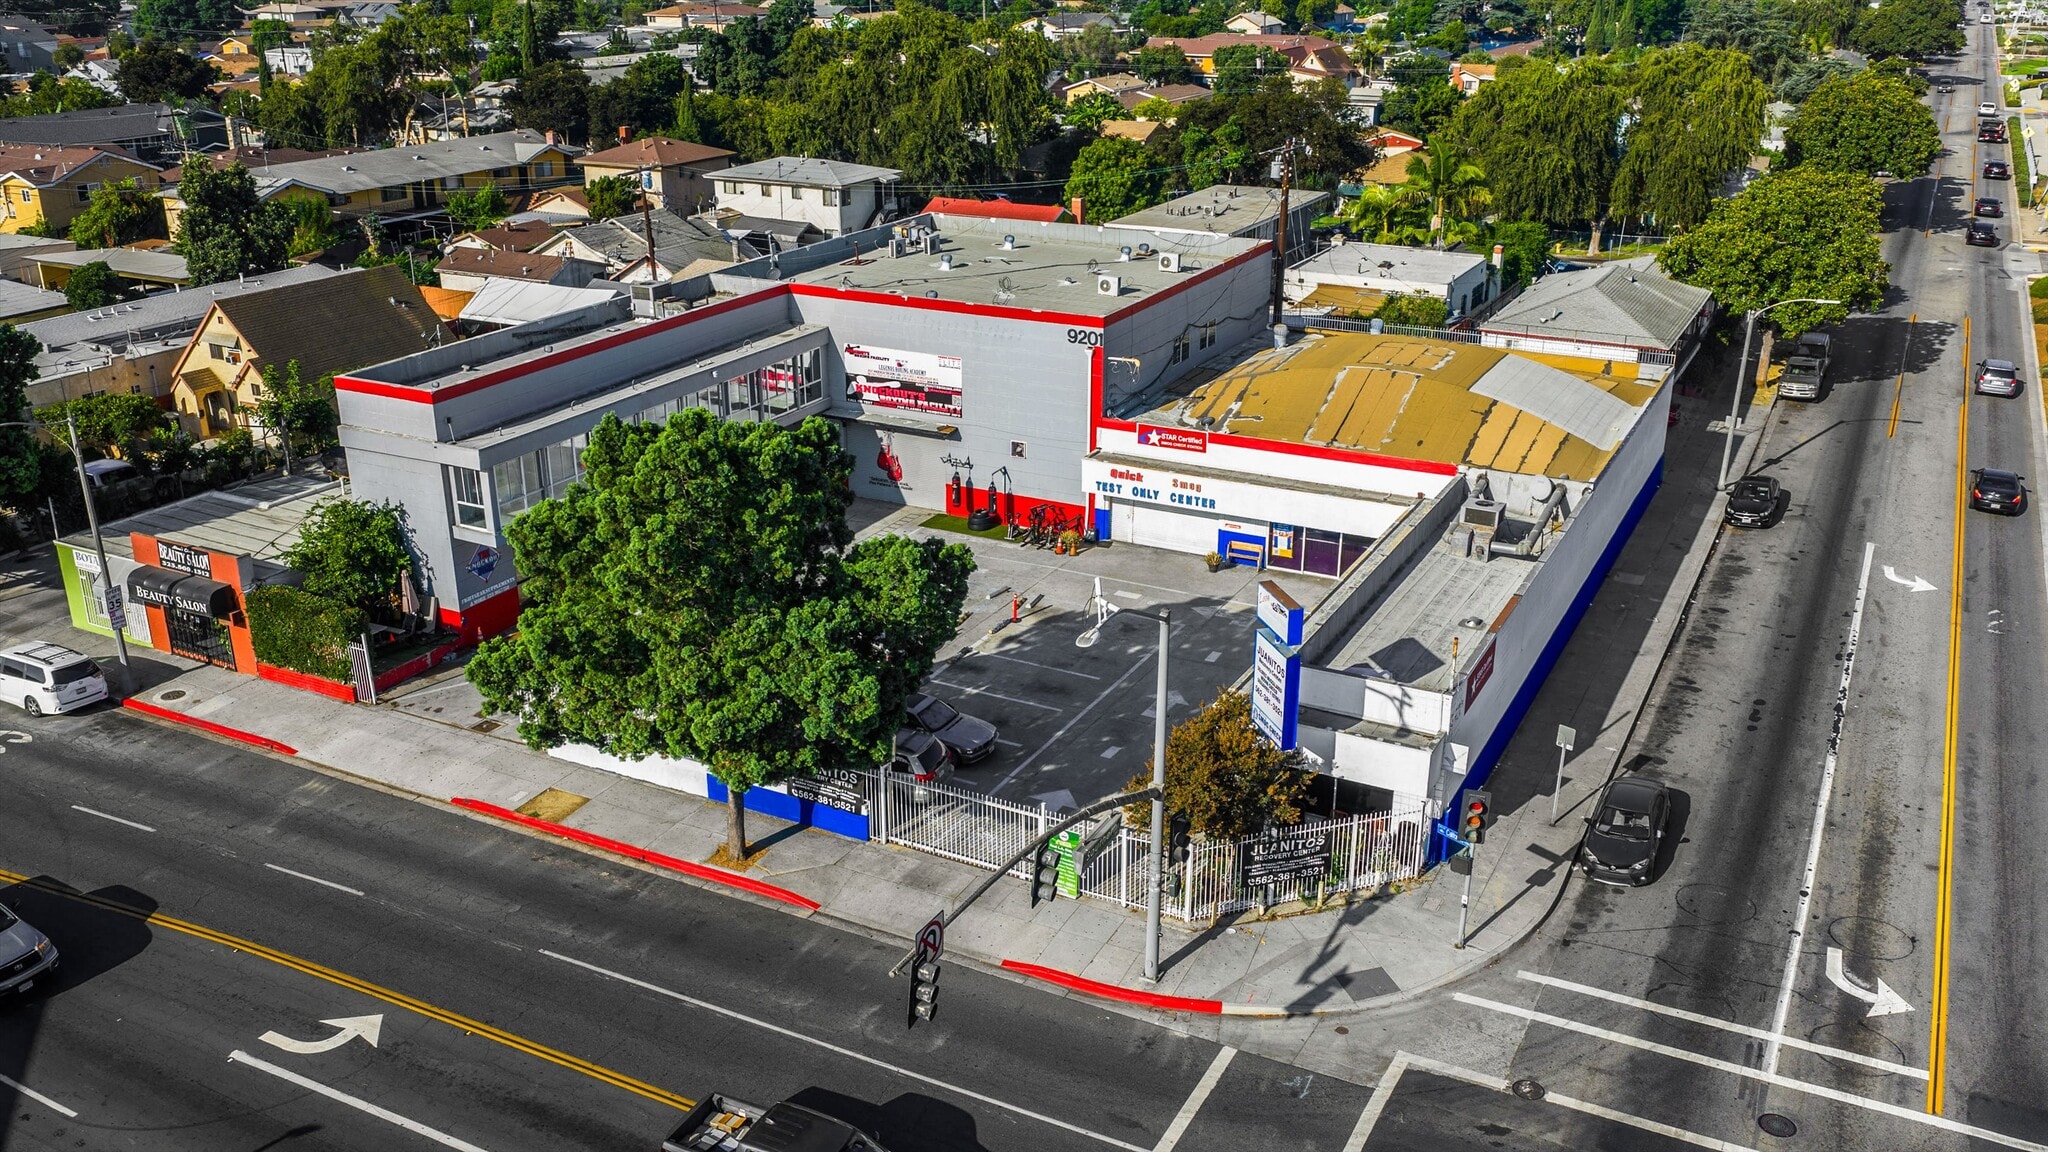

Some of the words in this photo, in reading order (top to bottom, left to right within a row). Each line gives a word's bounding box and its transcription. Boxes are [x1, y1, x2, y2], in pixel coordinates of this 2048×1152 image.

[1067, 328, 1104, 347] 9201
[855, 384, 926, 401] KNOCKOUT'S
[880, 395, 916, 410] BOXING
[918, 400, 962, 414] FACILITY
[1161, 432, 1177, 440] STAR
[1178, 436, 1202, 445] Certified
[1110, 468, 1144, 483] Quick
[1172, 478, 1202, 493] Smog
[1096, 480, 1122, 495] TEST
[1132, 486, 1160, 500] ONLY
[1170, 492, 1217, 510] CENTER
[158, 542, 186, 564] BEAUTY
[109, 599, 122, 611] 35
[136, 585, 174, 605] BEAUTY
[176, 596, 207, 614] SALON
[1258, 646, 1284, 678] JUANITOS
[1250, 836, 1326, 856] JUANITOS
[1254, 852, 1292, 862] RECOVERY
[1293, 846, 1321, 858] CENTER
